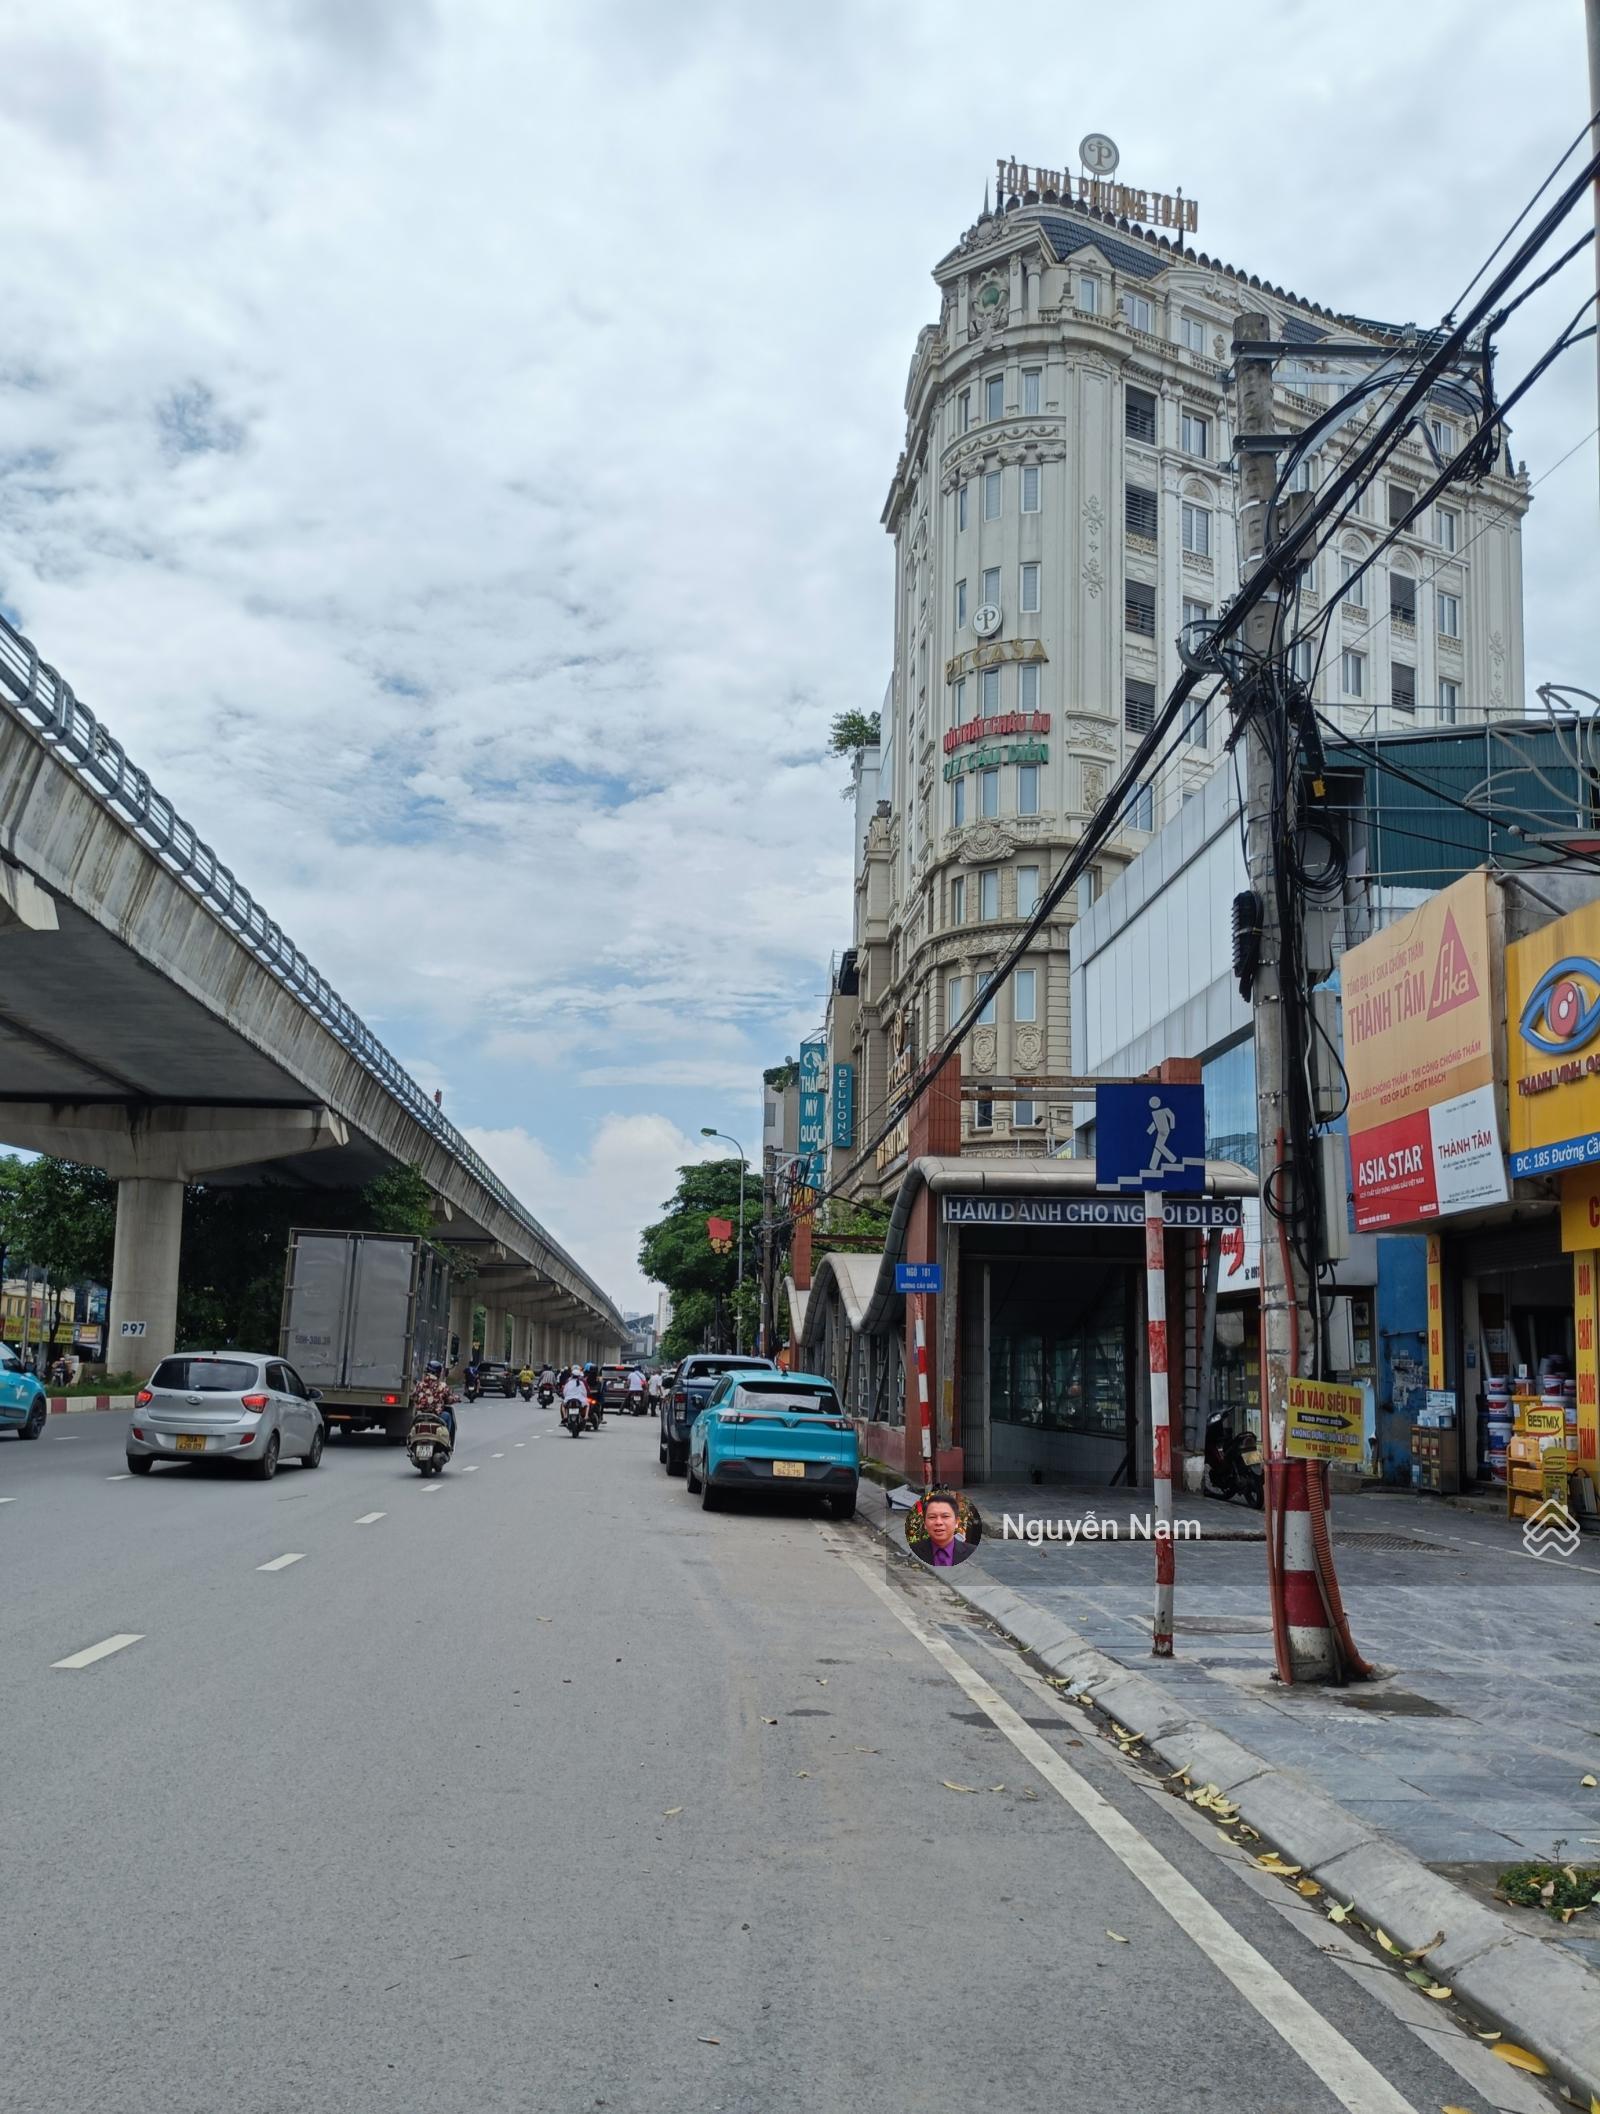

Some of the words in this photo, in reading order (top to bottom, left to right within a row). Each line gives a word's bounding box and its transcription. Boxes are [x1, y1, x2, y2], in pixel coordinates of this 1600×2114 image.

[973, 638, 1049, 667] CASA
[1432, 939, 1470, 1009] Sika
[1348, 993, 1392, 1045] THÀNH
[1394, 970, 1426, 1022] TÂM
[838, 1069, 848, 1140] BELLONA
[1438, 1138, 1470, 1160] THÀNH
[1471, 1130, 1492, 1151] TÂM
[1517, 1156, 1532, 1172] ĐC:
[1534, 1151, 1550, 1169] 185
[1552, 1143, 1584, 1164] Đường
[1359, 1158, 1387, 1187] ASIA
[1388, 1144, 1423, 1179] STAR
[1001, 1198, 1060, 1221] DÀNH
[1066, 1203, 1109, 1222] CHO
[1113, 1201, 1181, 1223] NGỜI
[1186, 1205, 1206, 1224] ĐI
[122, 1323, 146, 1335] P97
[1290, 1382, 1304, 1408] LỐI
[1307, 1386, 1325, 1410] VÀO
[1327, 1390, 1346, 1414] SIÊU
[1528, 1415, 1560, 1429] BESTMIX
